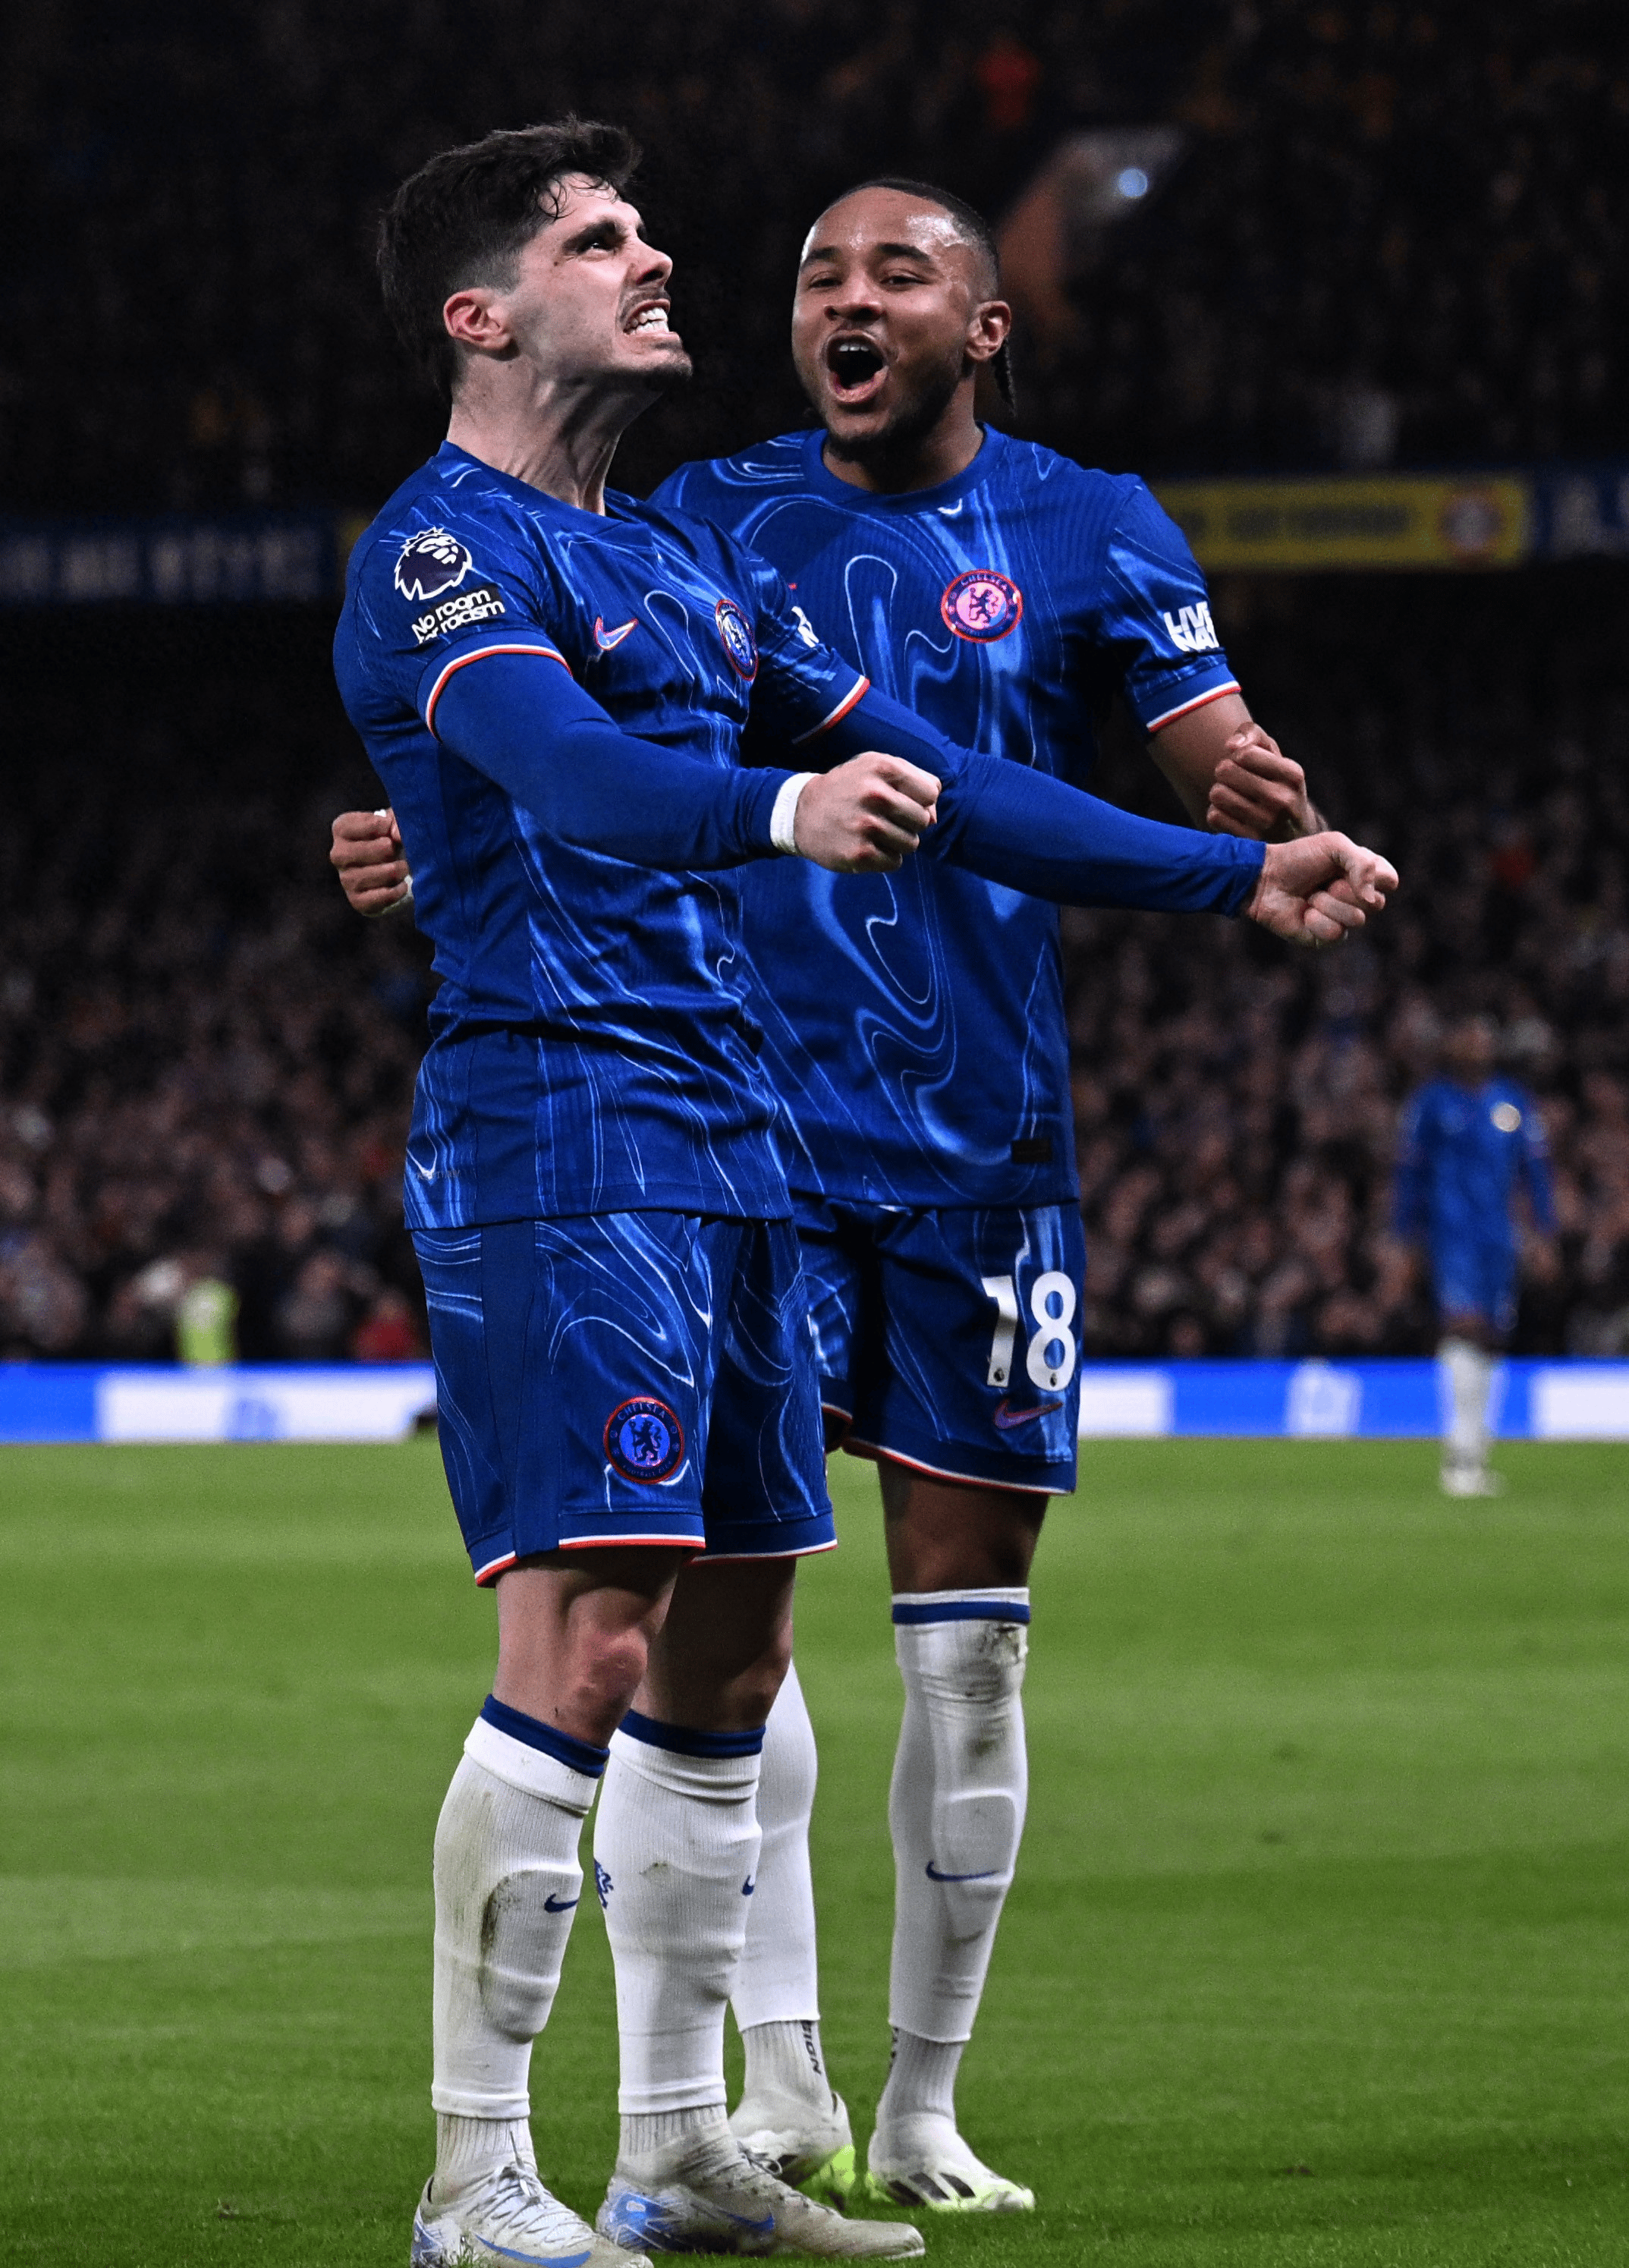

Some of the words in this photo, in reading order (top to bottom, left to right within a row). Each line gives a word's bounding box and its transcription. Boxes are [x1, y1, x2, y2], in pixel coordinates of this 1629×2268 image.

[411, 615, 436, 637] No
[435, 590, 491, 621] room
[441, 601, 505, 634] racism
[981, 1270, 1077, 1392] 18
